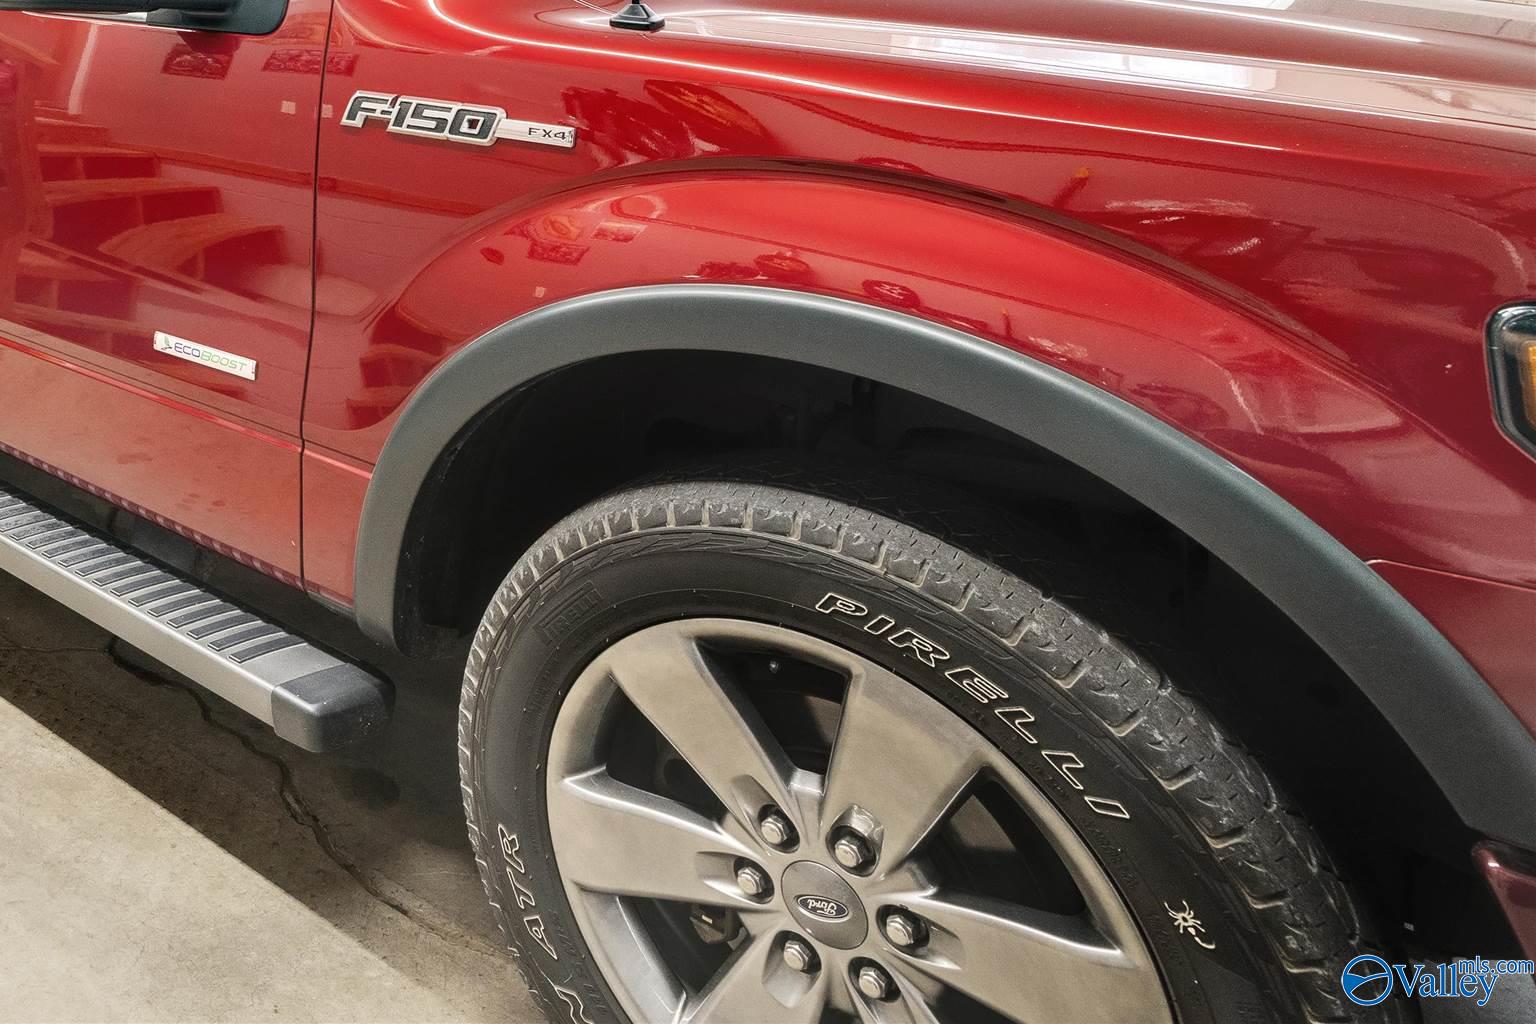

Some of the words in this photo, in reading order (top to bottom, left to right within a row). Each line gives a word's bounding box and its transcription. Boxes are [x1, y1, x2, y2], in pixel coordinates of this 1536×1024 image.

[343, 93, 503, 144] F-150
[528, 127, 567, 141] FX4
[815, 592, 1130, 819] PIRELLI
[497, 824, 558, 960] ATR
[806, 899, 837, 916] Ford
